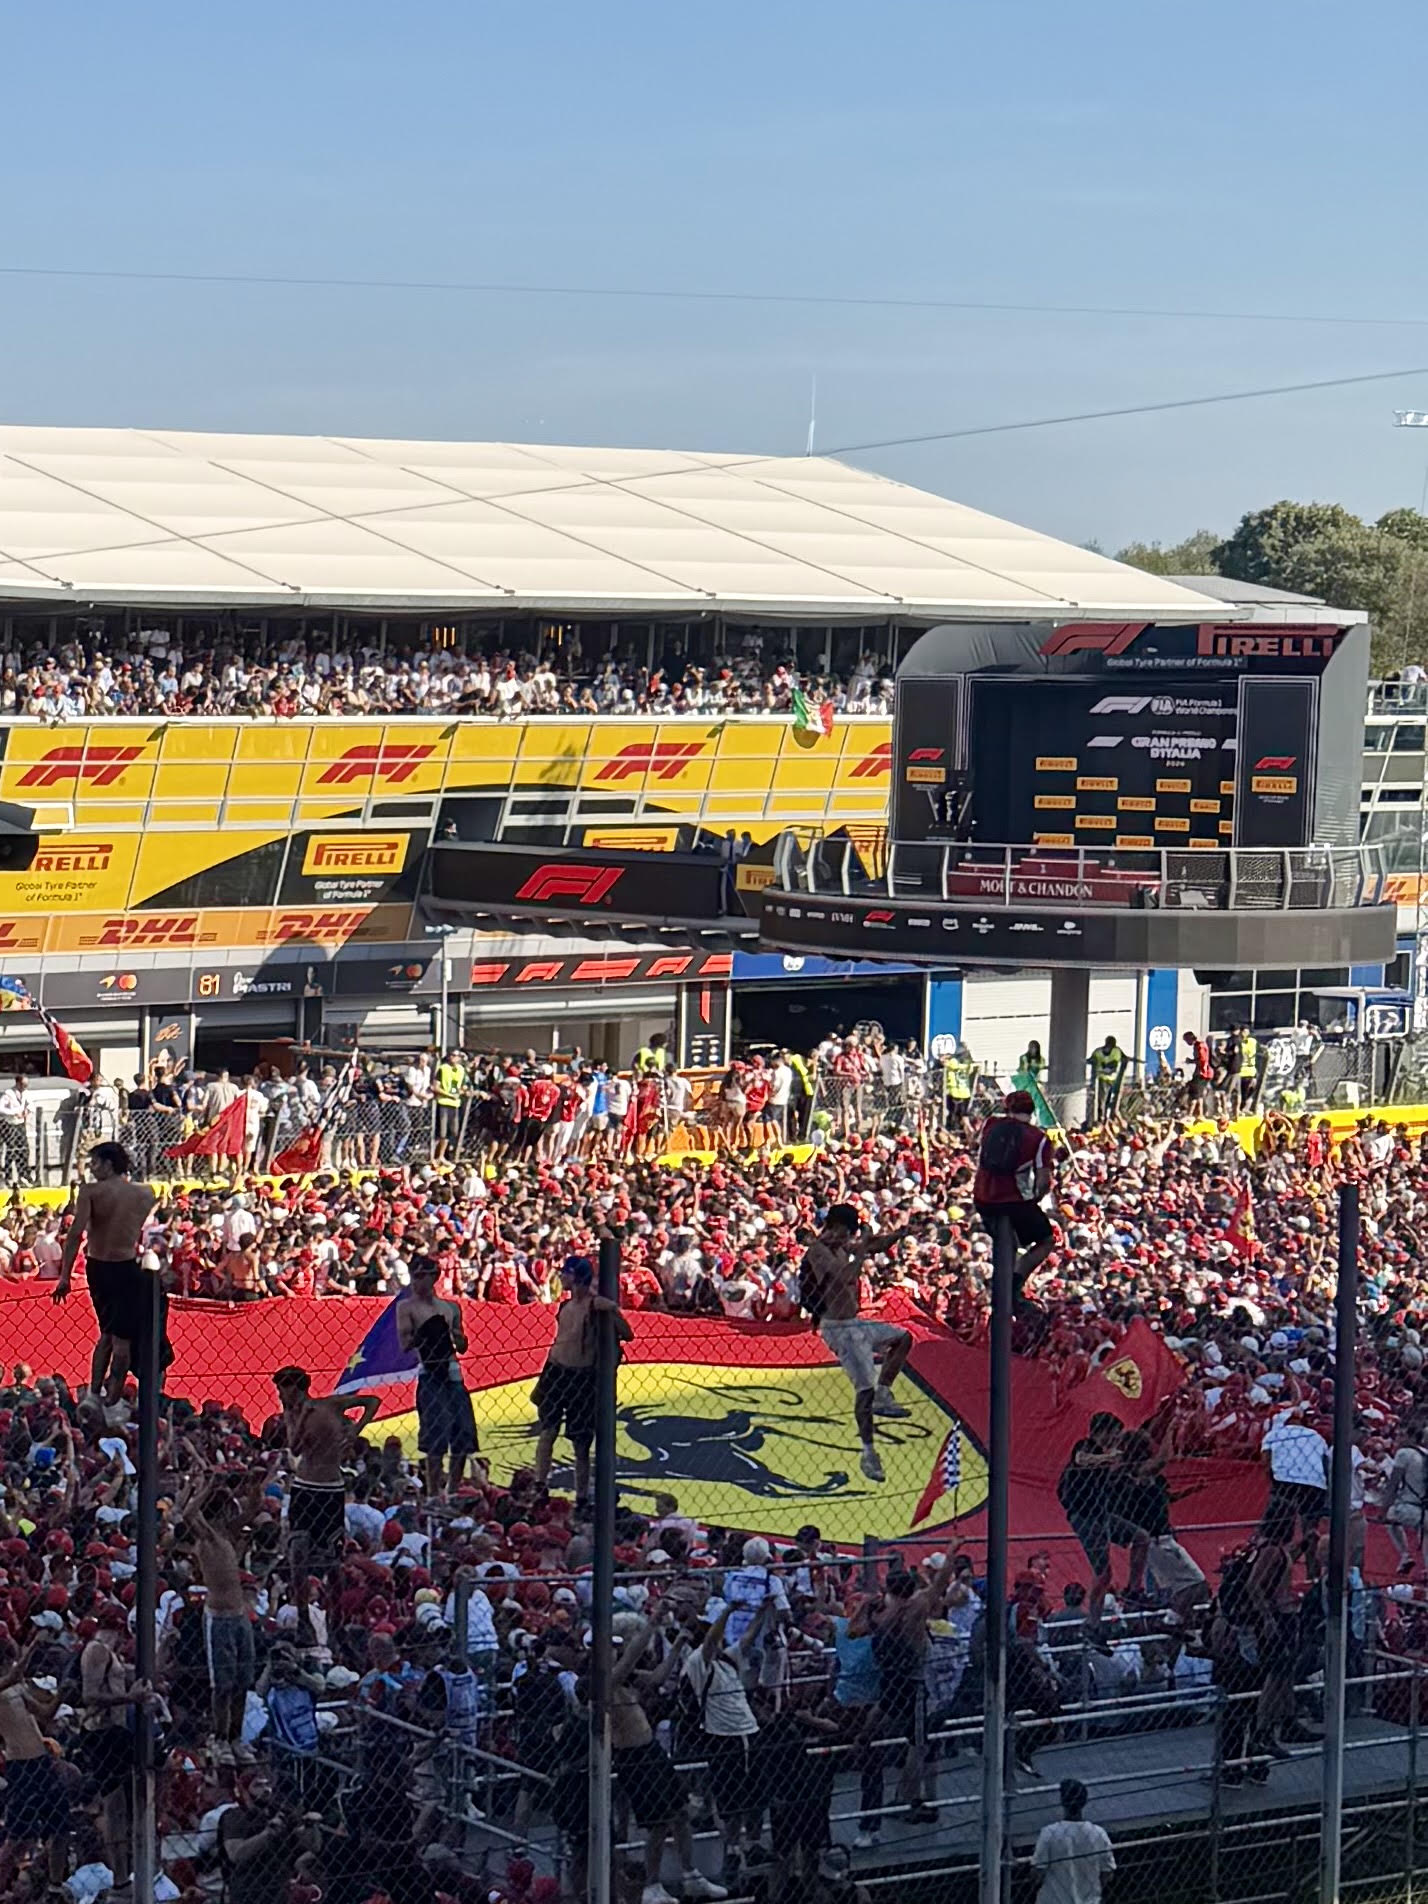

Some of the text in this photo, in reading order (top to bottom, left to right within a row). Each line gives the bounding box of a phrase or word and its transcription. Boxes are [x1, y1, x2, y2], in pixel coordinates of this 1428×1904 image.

[1197, 623, 1339, 657] PIRELLI
[1107, 657, 1132, 667] Global
[1154, 658, 1185, 667] Partner
[1197, 658, 1230, 667] Formula
[313, 842, 399, 866] PIRELLI
[15, 881, 43, 891] Global
[44, 881, 64, 892] Tyre
[314, 879, 338, 890] Global
[1028, 880, 1093, 898] CHANDON
[25, 892, 36, 902] of
[97, 917, 199, 945] DHL
[273, 912, 368, 939] DHL
[199, 974, 221, 995] 81
